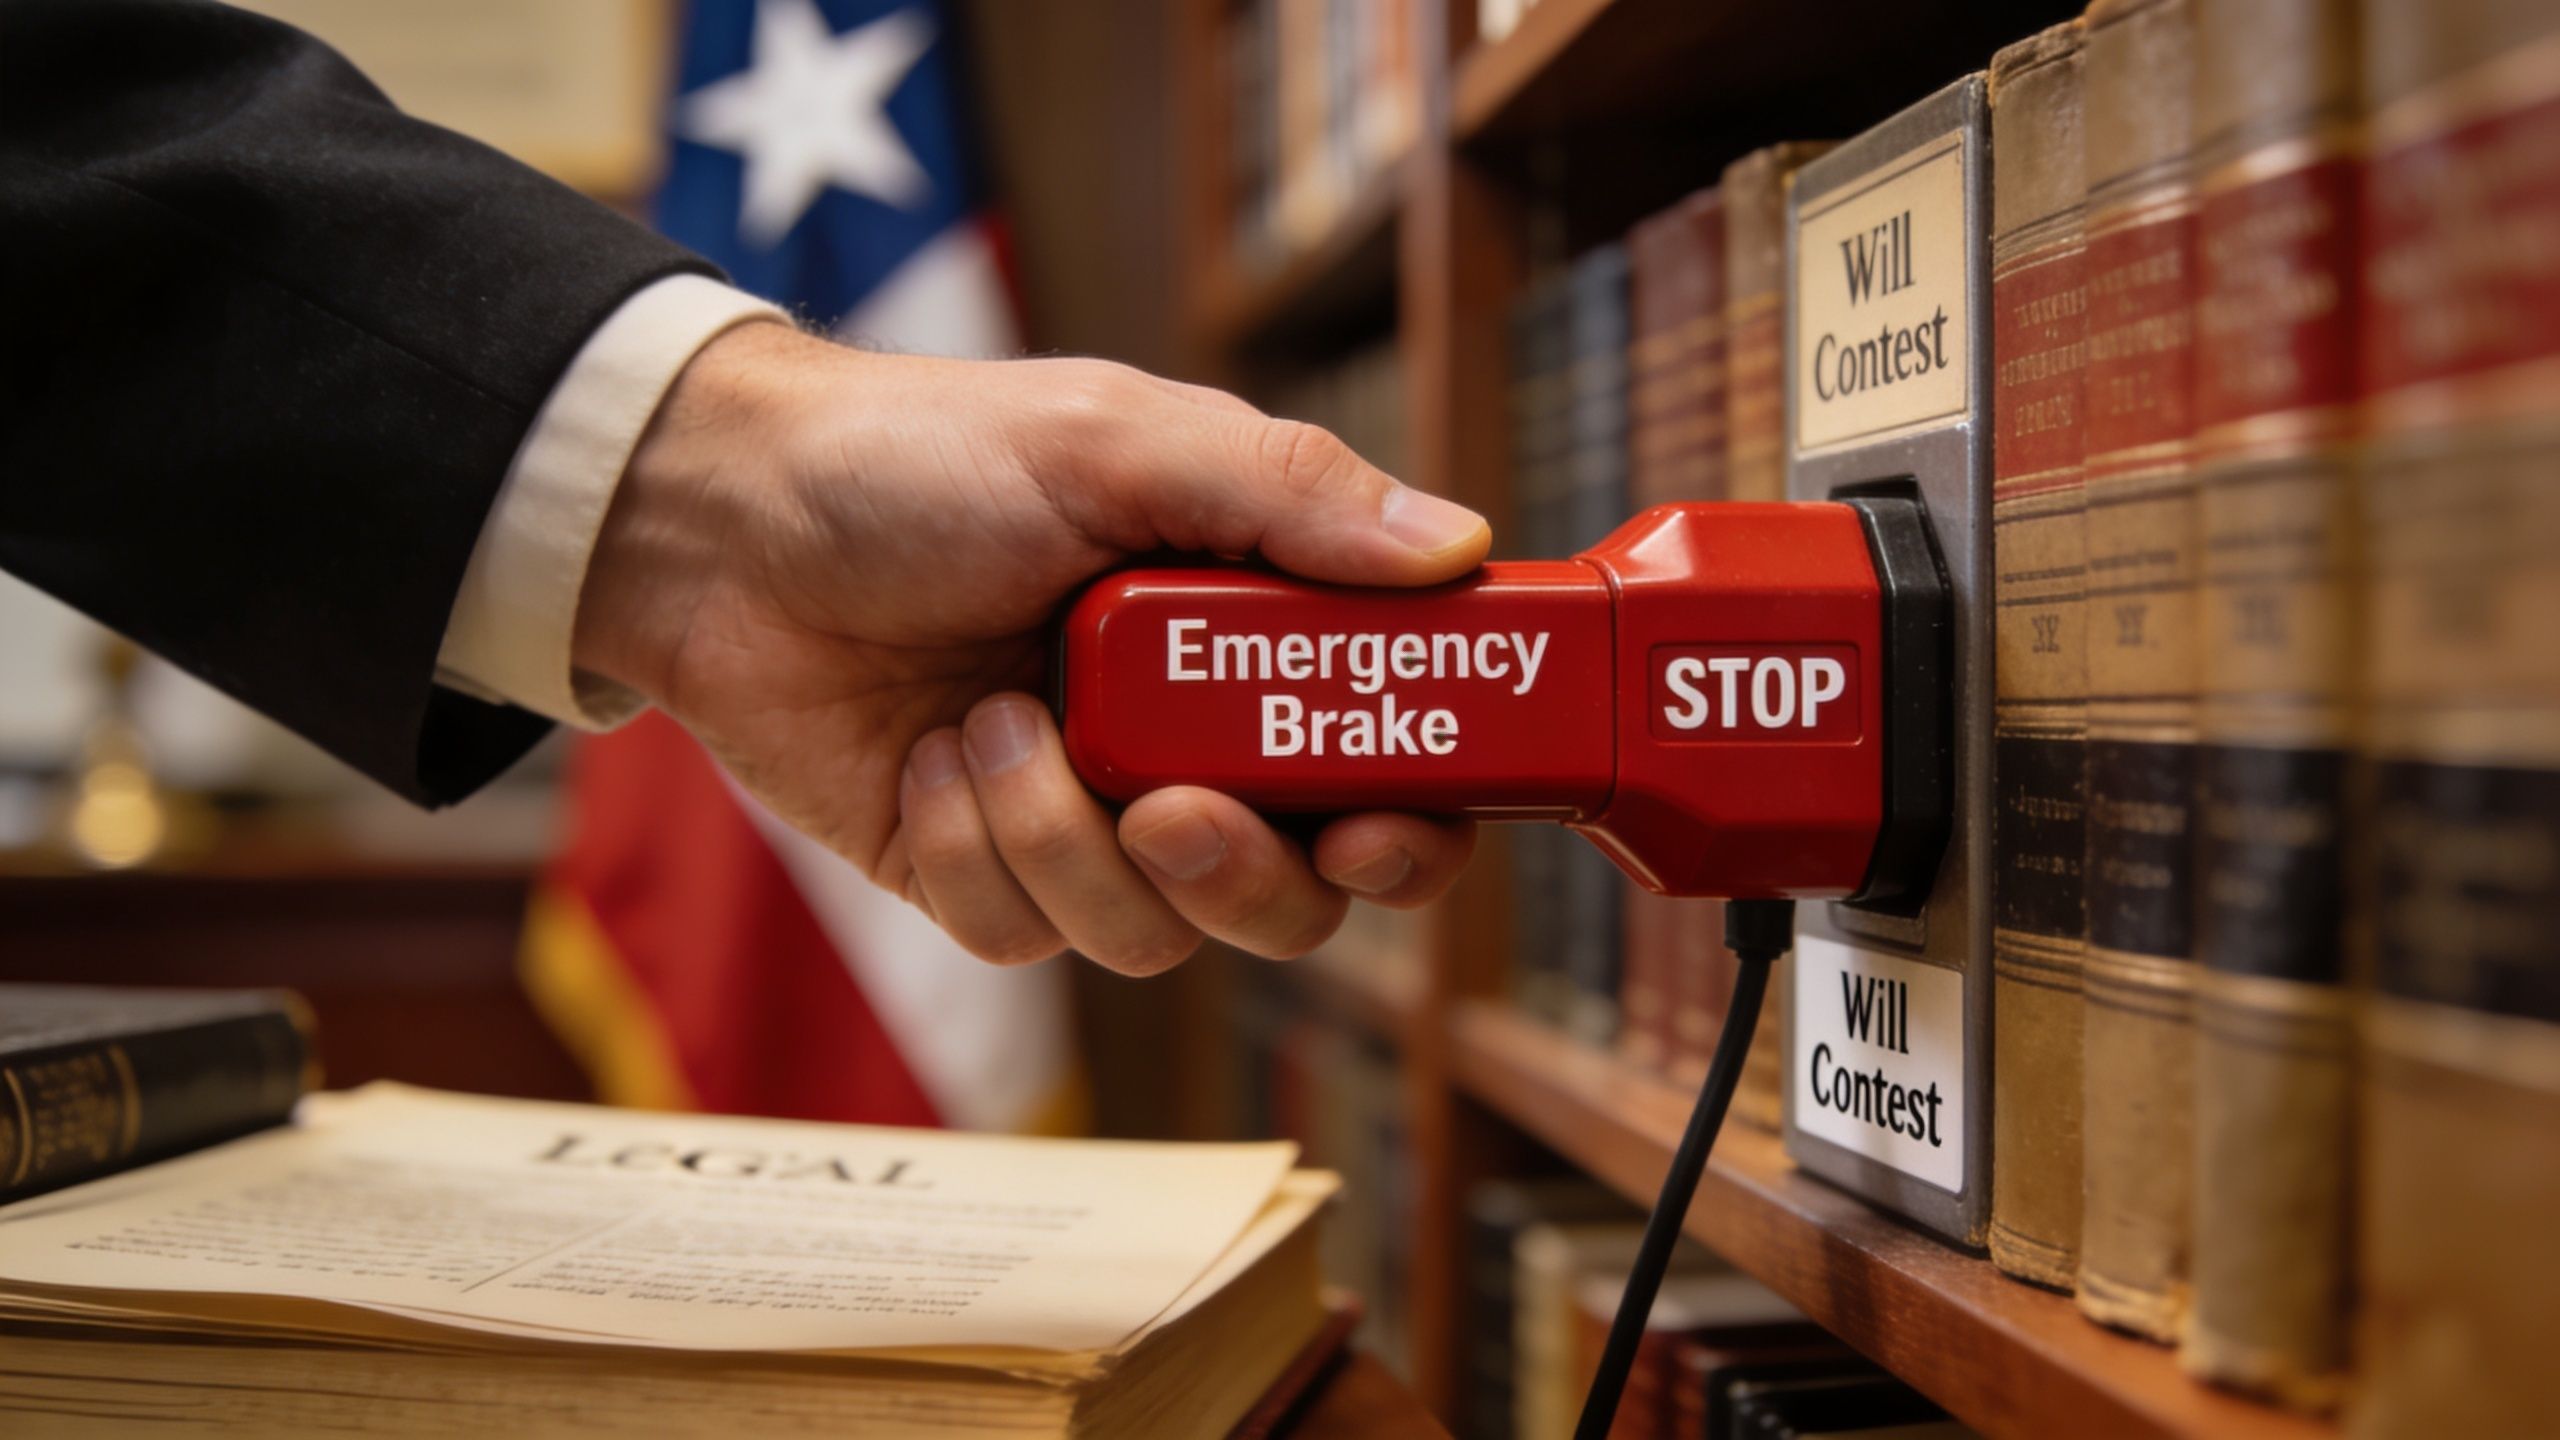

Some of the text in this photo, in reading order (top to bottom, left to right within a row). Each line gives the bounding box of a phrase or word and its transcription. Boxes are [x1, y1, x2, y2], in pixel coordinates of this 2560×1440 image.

[1839, 209, 1915, 307] Will
[1814, 304, 1950, 403] Contest
[1166, 618, 1550, 694] Emergency
[1664, 656, 1845, 729] STOP
[1261, 694, 1459, 757] Brake
[1840, 970, 1910, 1055] Will
[1811, 1042, 1944, 1149] Contest
